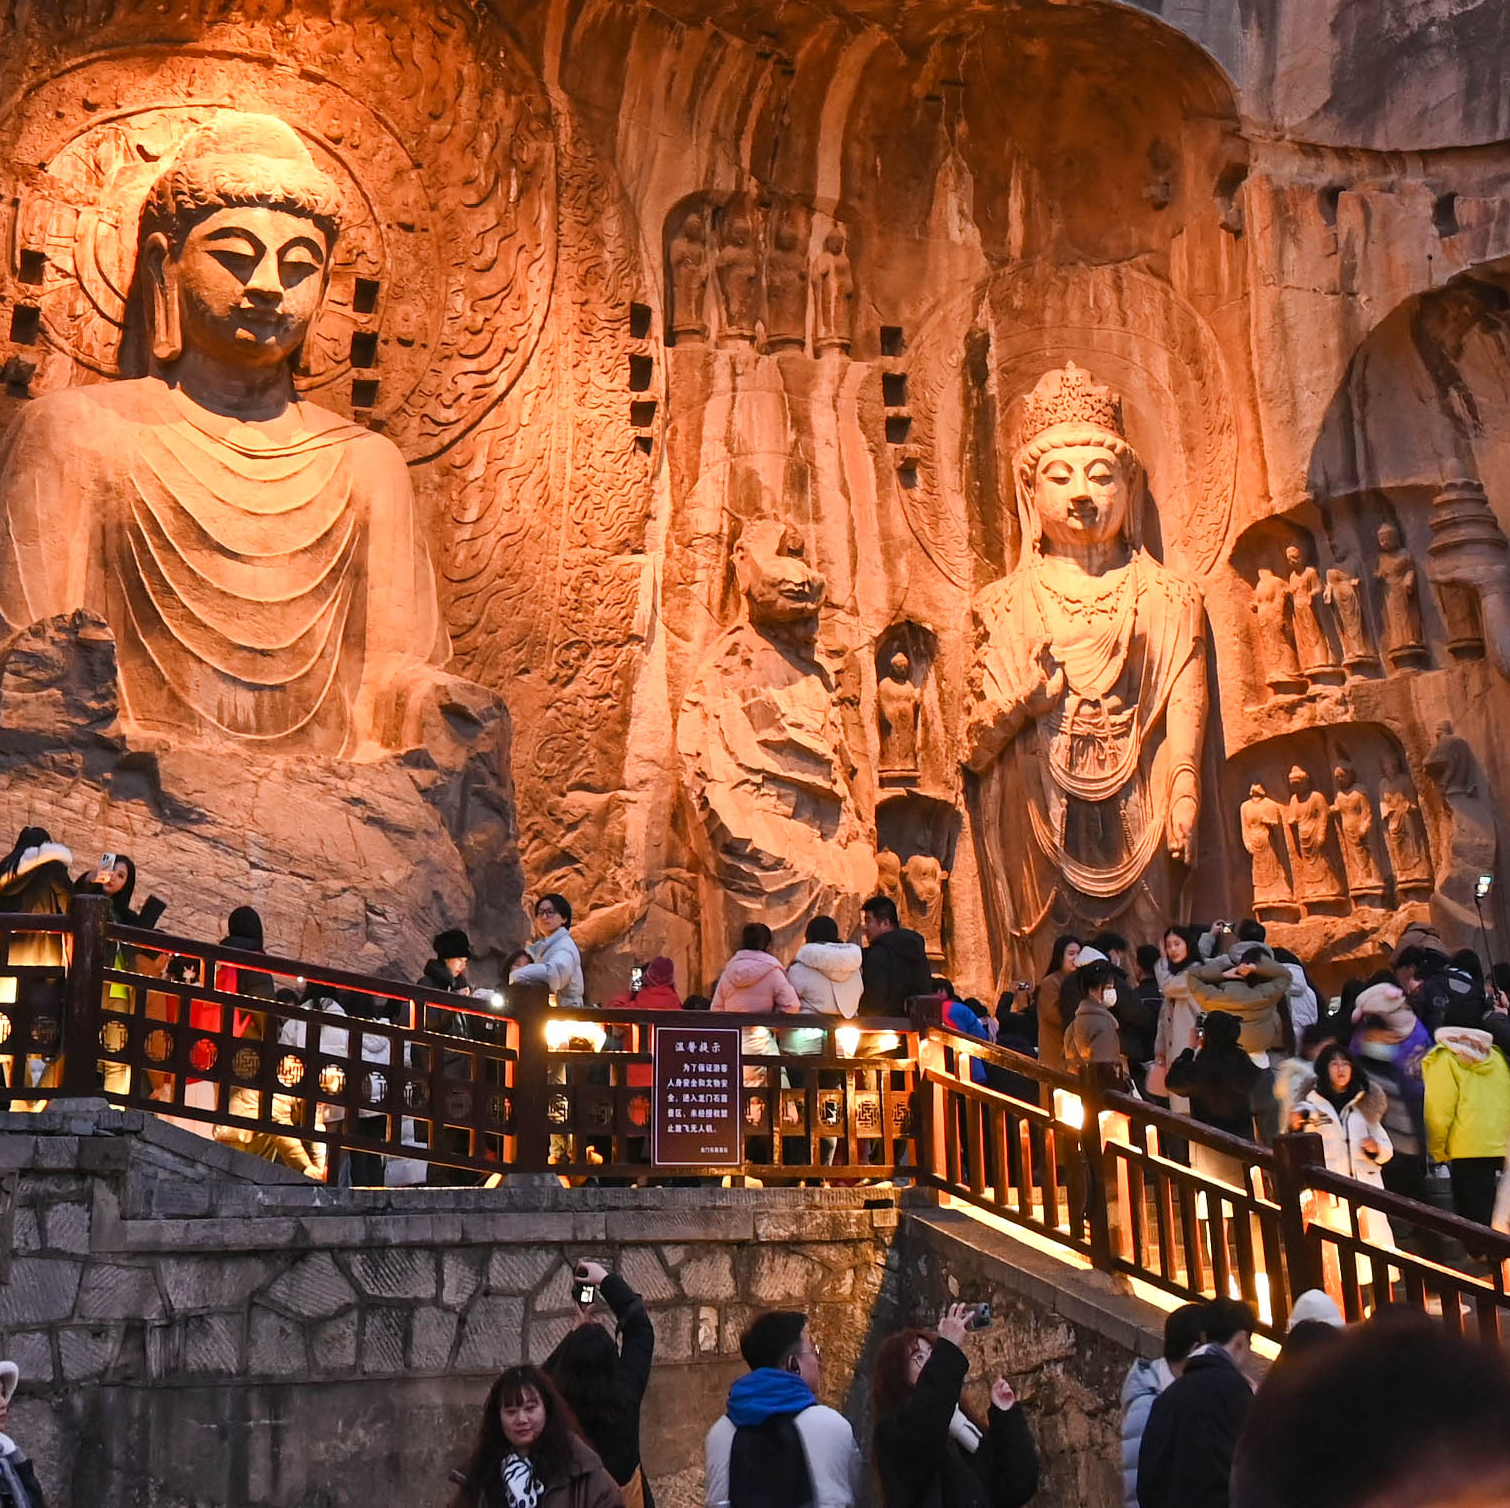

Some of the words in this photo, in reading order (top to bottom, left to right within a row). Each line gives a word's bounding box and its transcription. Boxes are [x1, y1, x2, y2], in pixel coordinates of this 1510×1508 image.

[675, 1041, 721, 1053] 温馨提示
[683, 1063, 728, 1073] 为了保证游客
[667, 1078, 728, 1089] 人身安全和文物安
